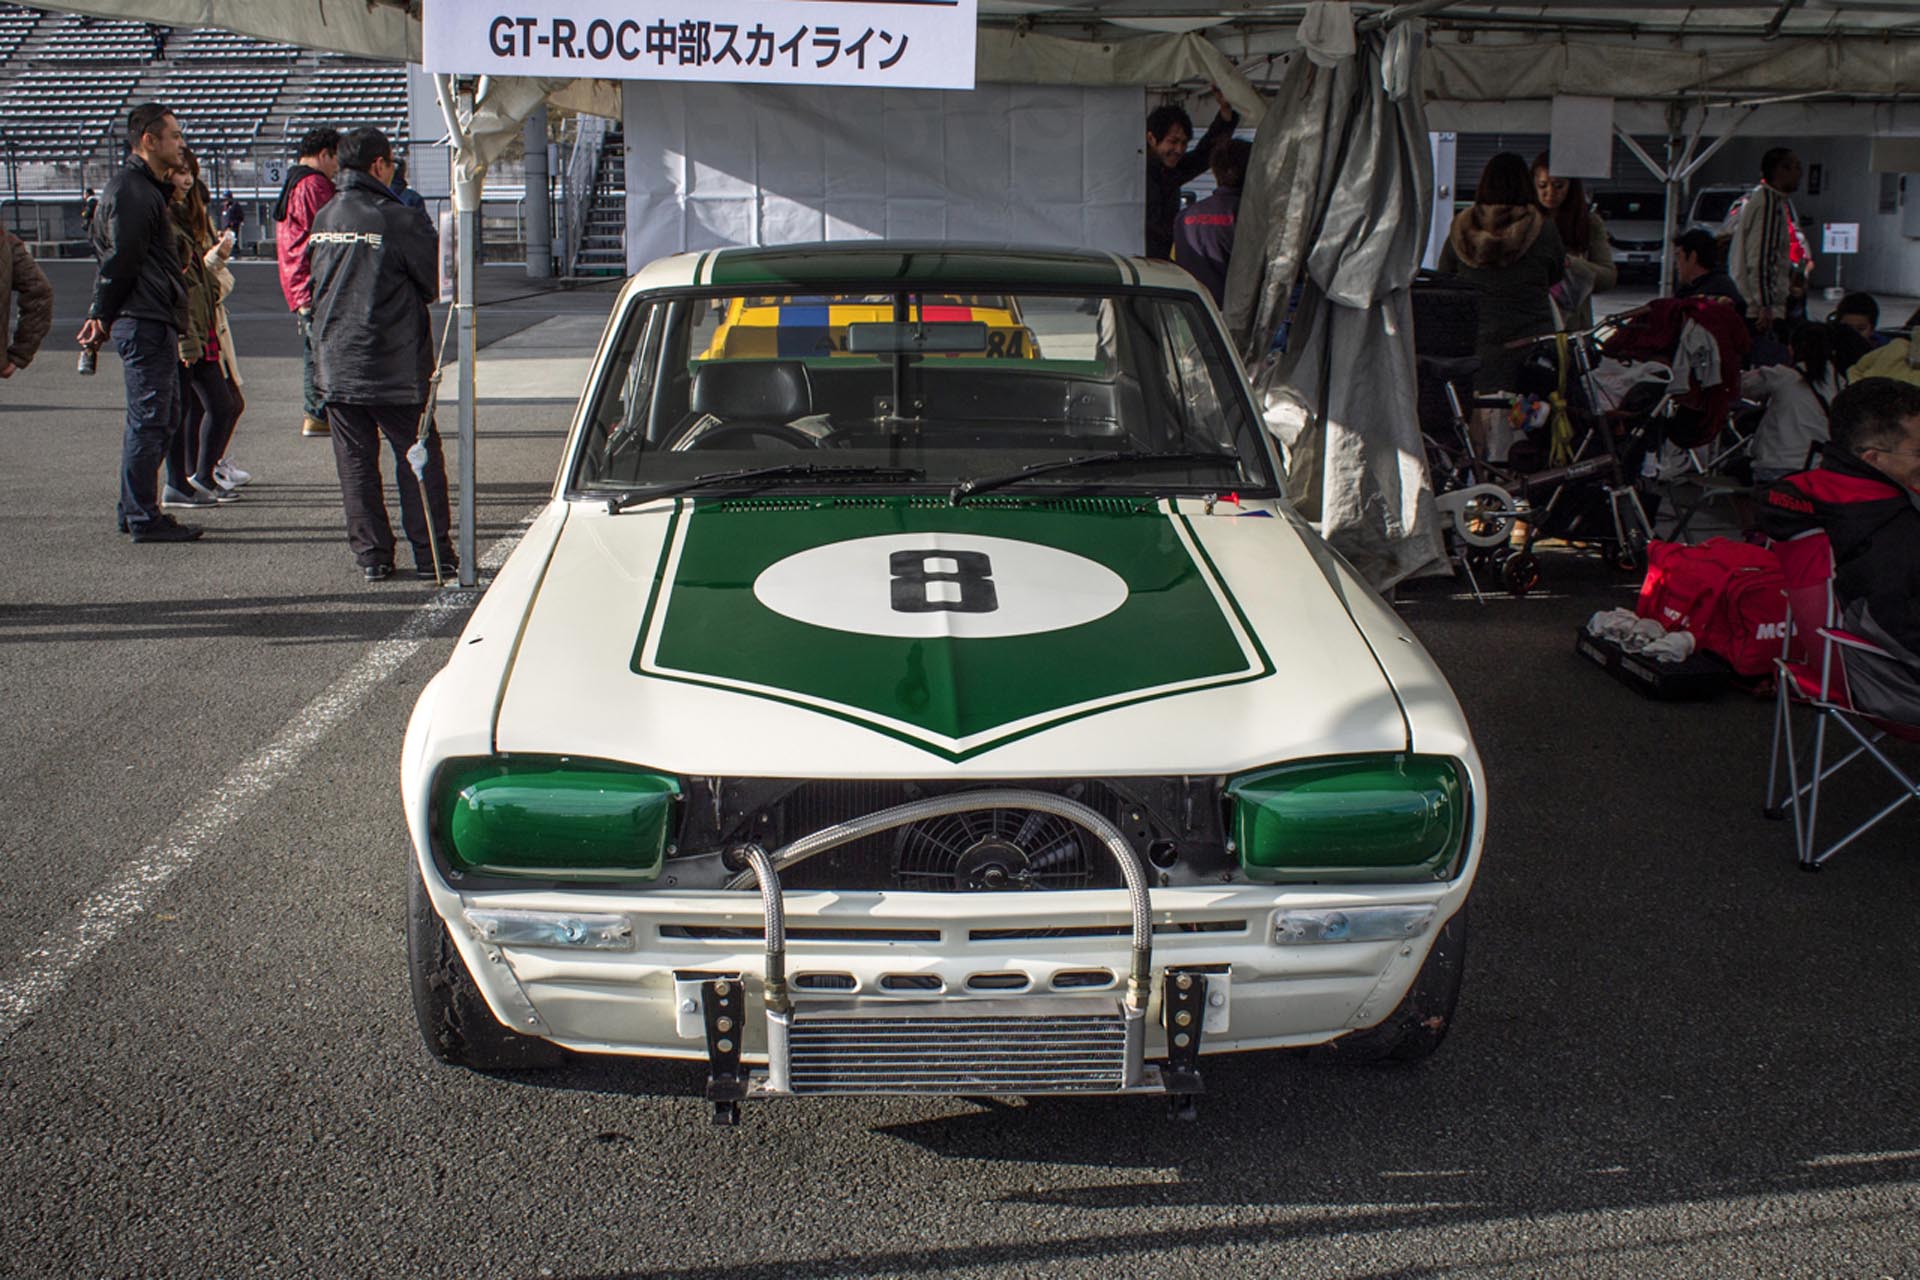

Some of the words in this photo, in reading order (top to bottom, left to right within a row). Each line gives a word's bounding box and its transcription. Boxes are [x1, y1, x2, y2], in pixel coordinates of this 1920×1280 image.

[488, 16, 910, 71] GT-R.OC中部スカイライン
[271, 168, 280, 182] 3
[889, 549, 999, 613] 8
